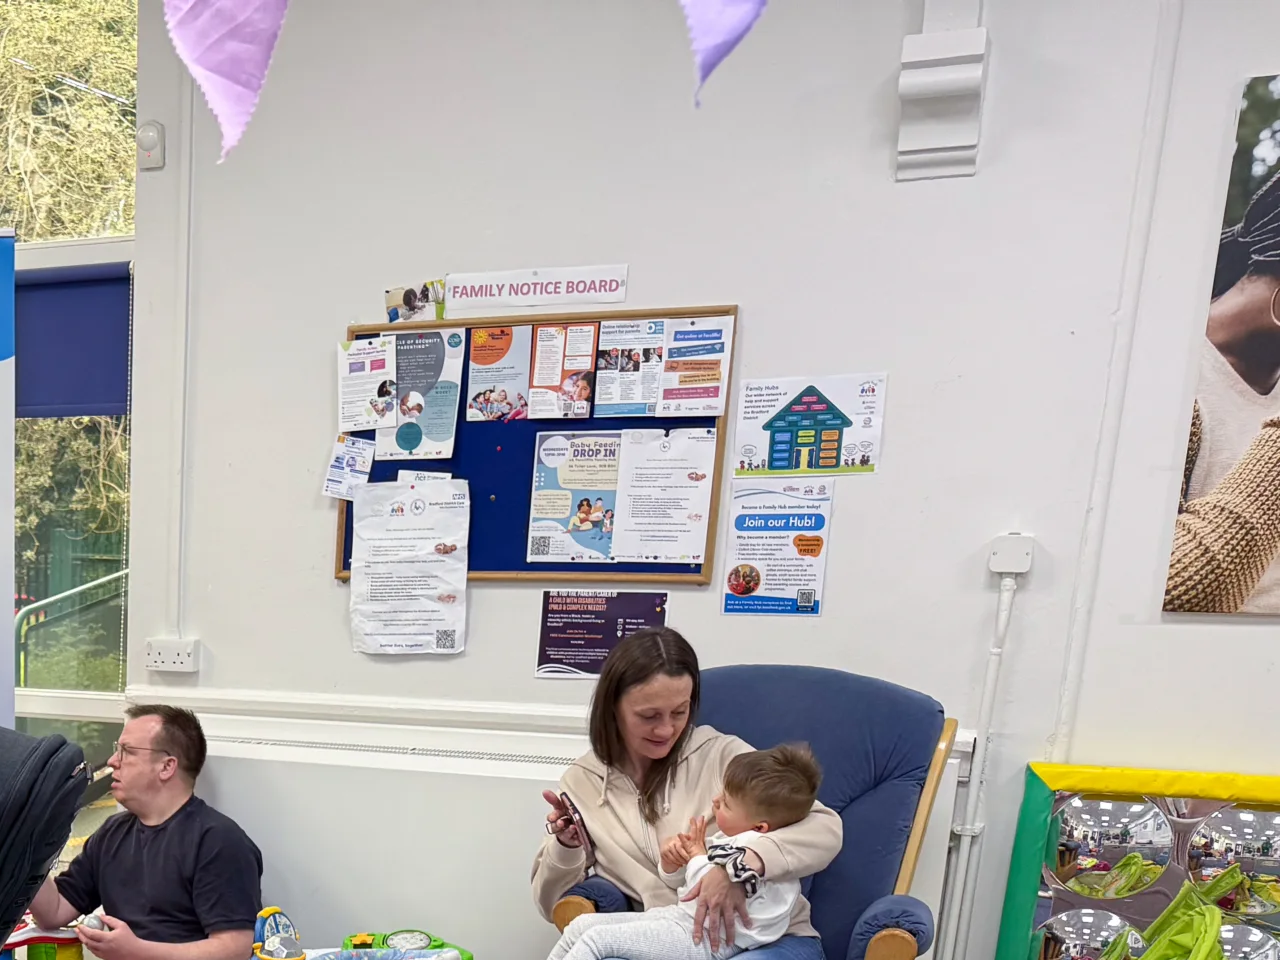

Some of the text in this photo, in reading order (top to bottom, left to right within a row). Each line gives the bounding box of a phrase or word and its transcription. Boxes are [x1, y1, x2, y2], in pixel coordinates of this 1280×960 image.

[452, 278, 620, 298] FAMILY NOTICE BOARD
[570, 441, 591, 449] Baby
[573, 448, 616, 458] DROP IN
[743, 515, 815, 527] Join our Hub!
